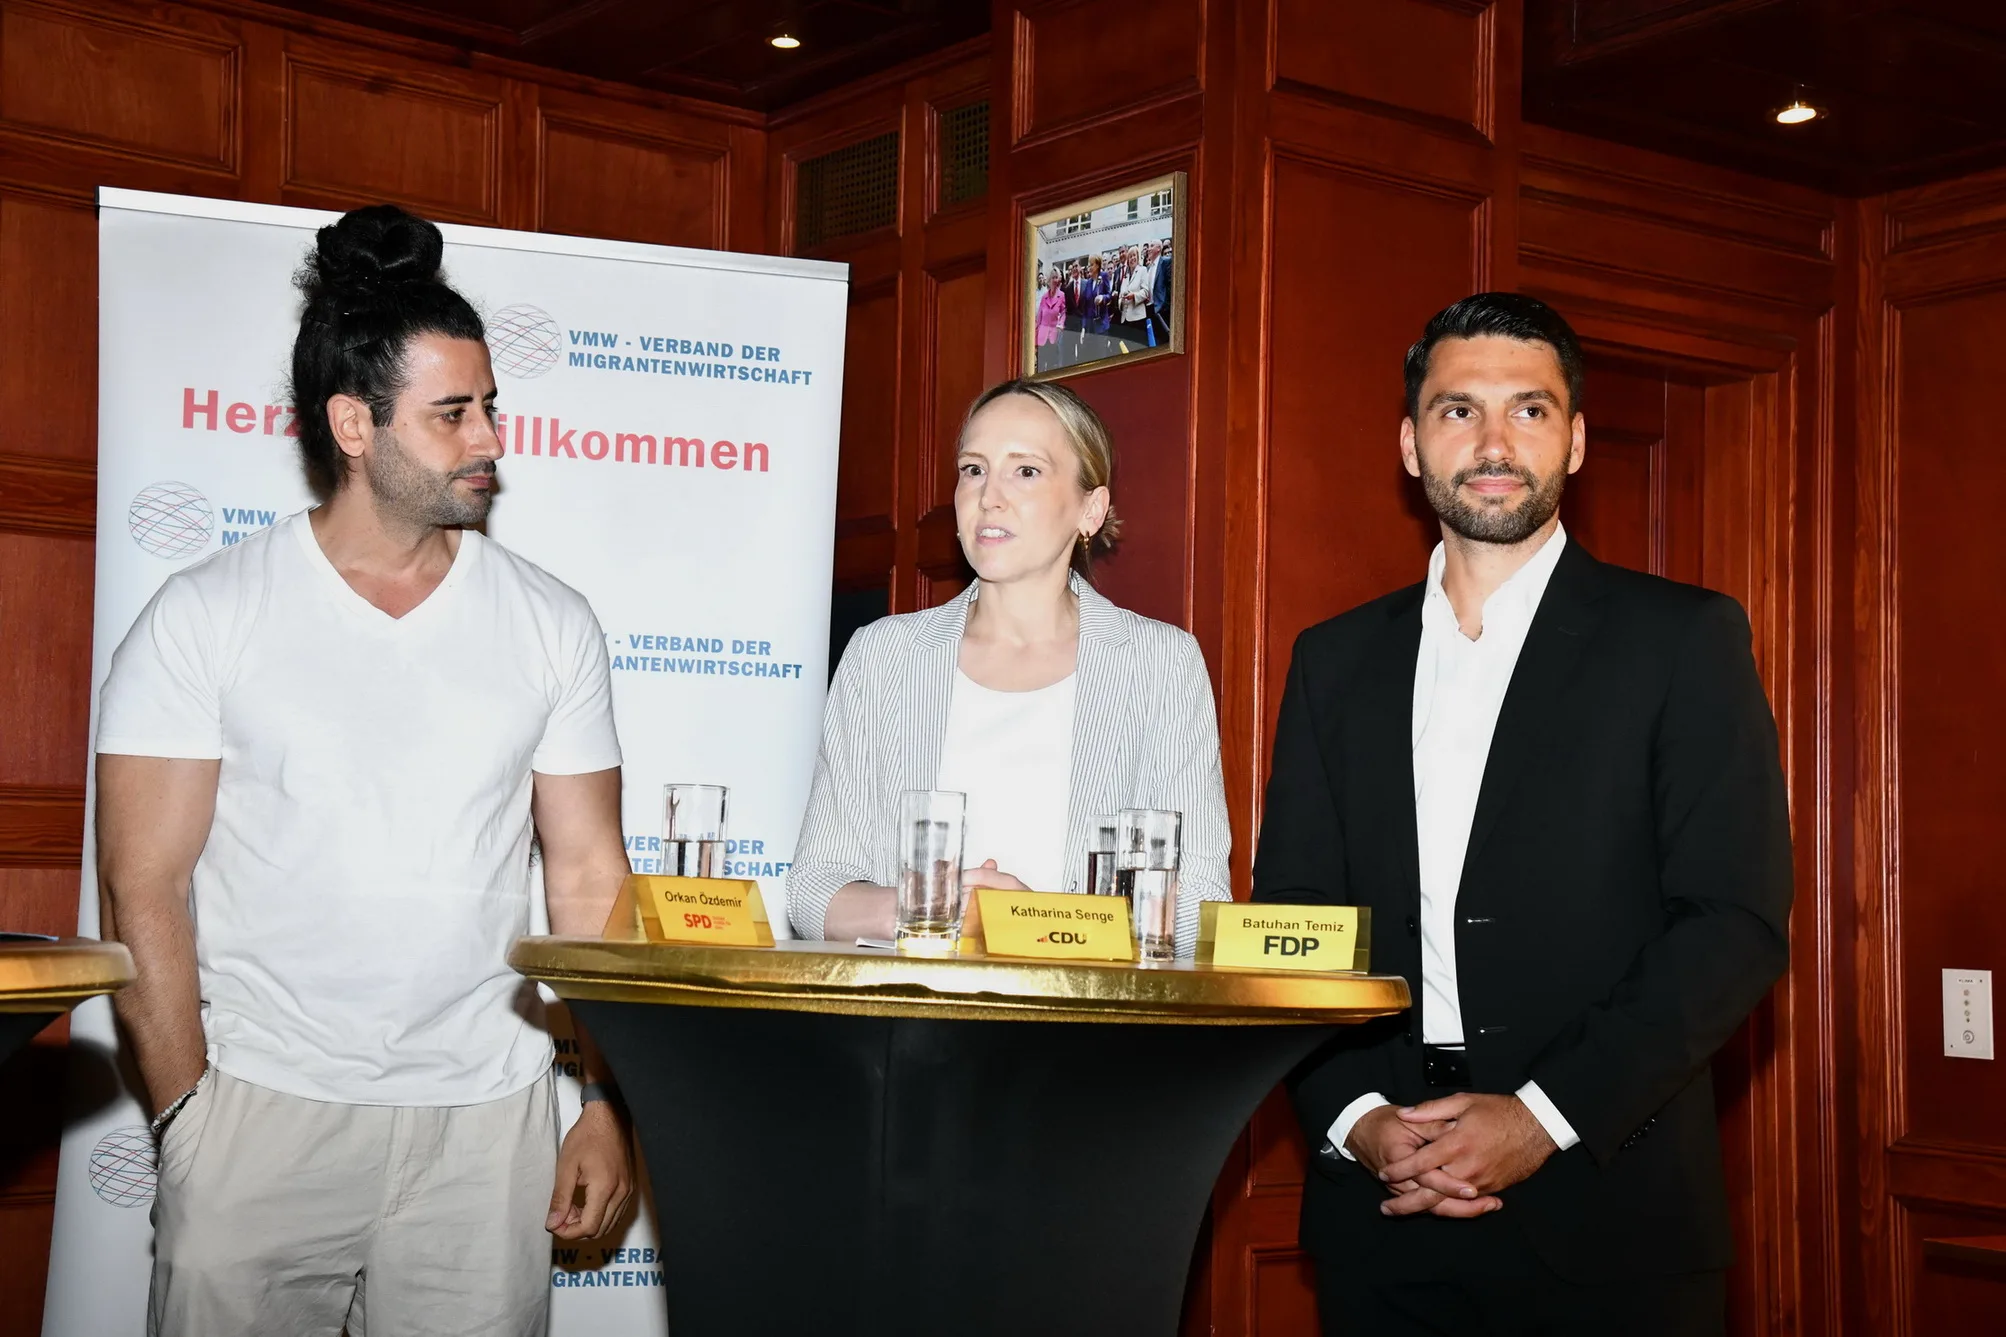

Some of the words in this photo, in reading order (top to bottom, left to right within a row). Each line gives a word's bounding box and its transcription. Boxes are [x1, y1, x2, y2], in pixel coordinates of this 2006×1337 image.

[568, 330, 619, 348] VMW
[639, 336, 734, 358] VERBAND
[741, 345, 781, 362] DER
[568, 352, 813, 386] MIGRANTENWIRTSCHAFT
[222, 508, 277, 527] VMW
[629, 634, 724, 653] VERBAND
[732, 640, 771, 656] DER
[725, 839, 765, 855] DER
[665, 891, 698, 905] Orkan
[699, 891, 742, 908] Özdemir
[684, 913, 712, 929] SPD
[1010, 906, 1072, 920] Katharina
[1075, 909, 1115, 924] Senge
[1242, 918, 1300, 931] Batuhan
[1305, 920, 1344, 932] Temiz
[1048, 931, 1087, 945] CDU
[1263, 935, 1320, 957] FDP
